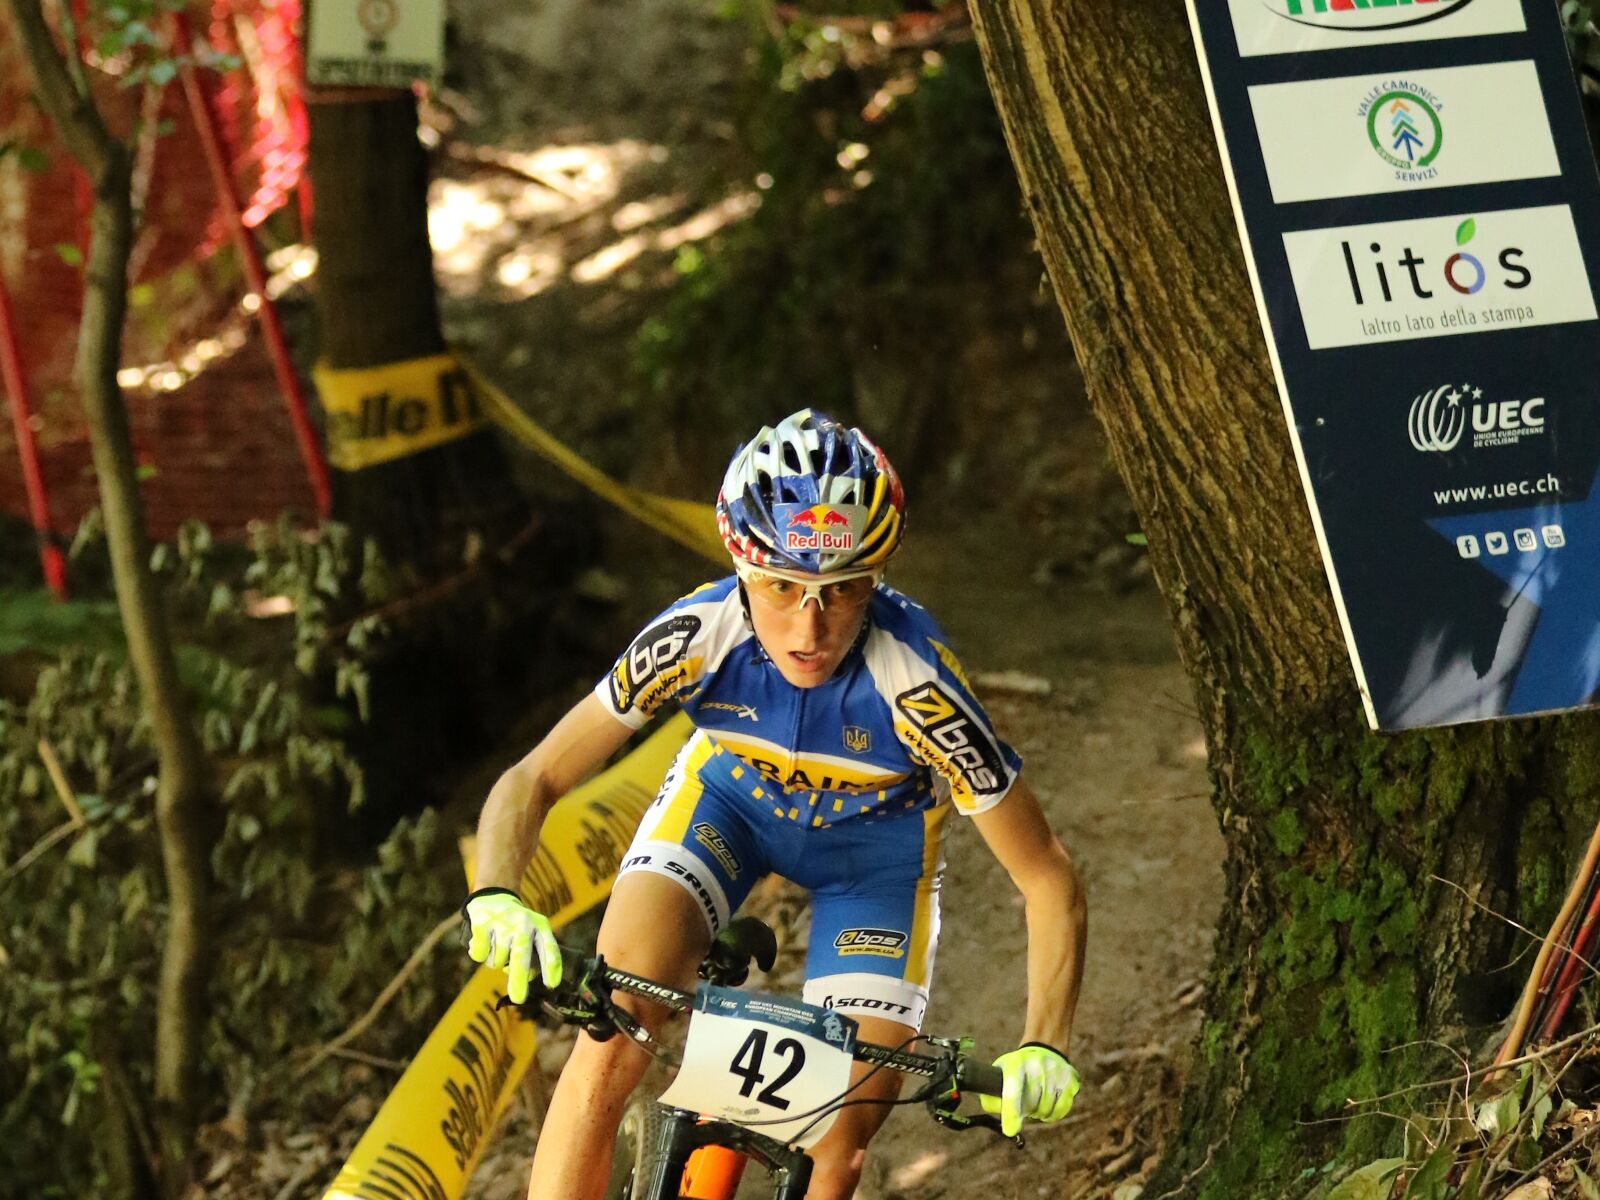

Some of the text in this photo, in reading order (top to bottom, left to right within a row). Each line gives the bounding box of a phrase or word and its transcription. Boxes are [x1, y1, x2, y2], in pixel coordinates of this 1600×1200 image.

[1358, 80, 1444, 117] VALLE CAMONICA
[1395, 167, 1438, 181] SERVIZI
[1406, 314, 1435, 330] lato
[1440, 307, 1477, 328] della
[1482, 306, 1535, 325] stampa
[1472, 397, 1545, 432] UEC
[1473, 433, 1497, 441] UNION
[1473, 437, 1519, 448] DE CYCLISME
[1433, 473, 1560, 505] www.uec.ch
[787, 533, 853, 549] Red Bull
[932, 718, 999, 790] bps
[854, 931, 901, 947] bps
[610, 973, 684, 1000] RITCHEY
[835, 998, 912, 1015] SCOTT
[729, 1028, 806, 1111] 42
[441, 1078, 483, 1171] selle
